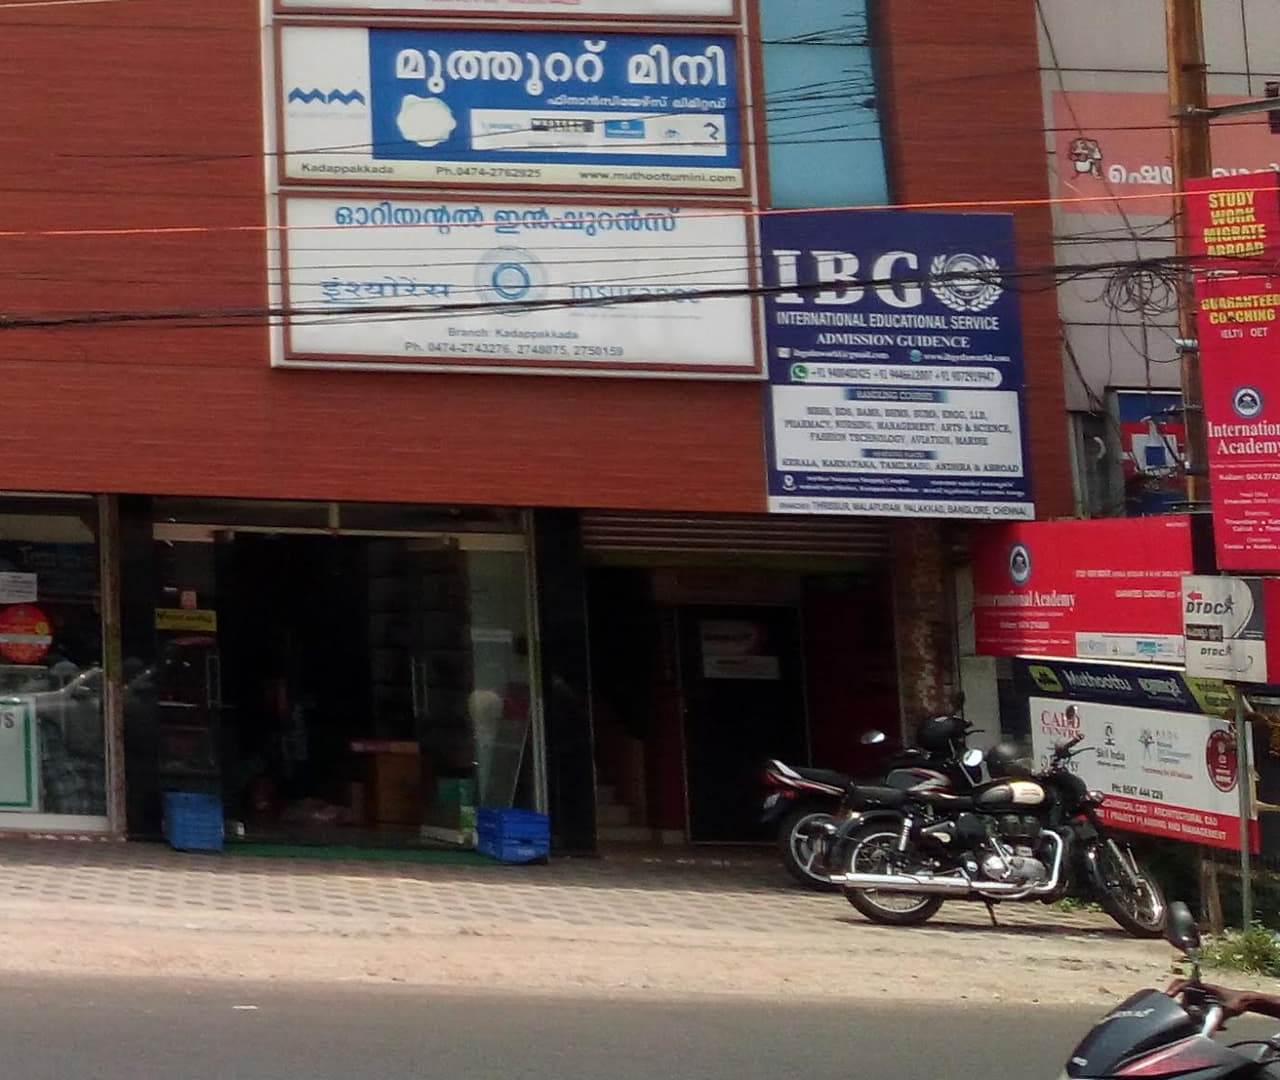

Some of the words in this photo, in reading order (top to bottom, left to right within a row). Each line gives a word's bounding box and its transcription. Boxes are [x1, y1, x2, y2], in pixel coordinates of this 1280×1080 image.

[626, 43, 728, 87] മിനി
[301, 163, 394, 175] Kadappakkada
[1208, 191, 1255, 208] STUDY
[1210, 208, 1256, 225] WORK
[1203, 224, 1267, 243] MIGRATE
[1207, 242, 1265, 258] ABROAD
[772, 249, 922, 308] IBG
[776, 311, 867, 327] INTERNATIONAL
[869, 313, 948, 329] EDUCATIONAL
[951, 315, 1000, 330] SERVICE
[1209, 309, 1276, 324] COACHING
[816, 333, 894, 345] ADMISSION
[897, 335, 971, 348] GUIDENCE
[1033, 589, 1076, 612] Academy
[1185, 601, 1224, 615] DTDC
[1200, 647, 1225, 656] DTDC
